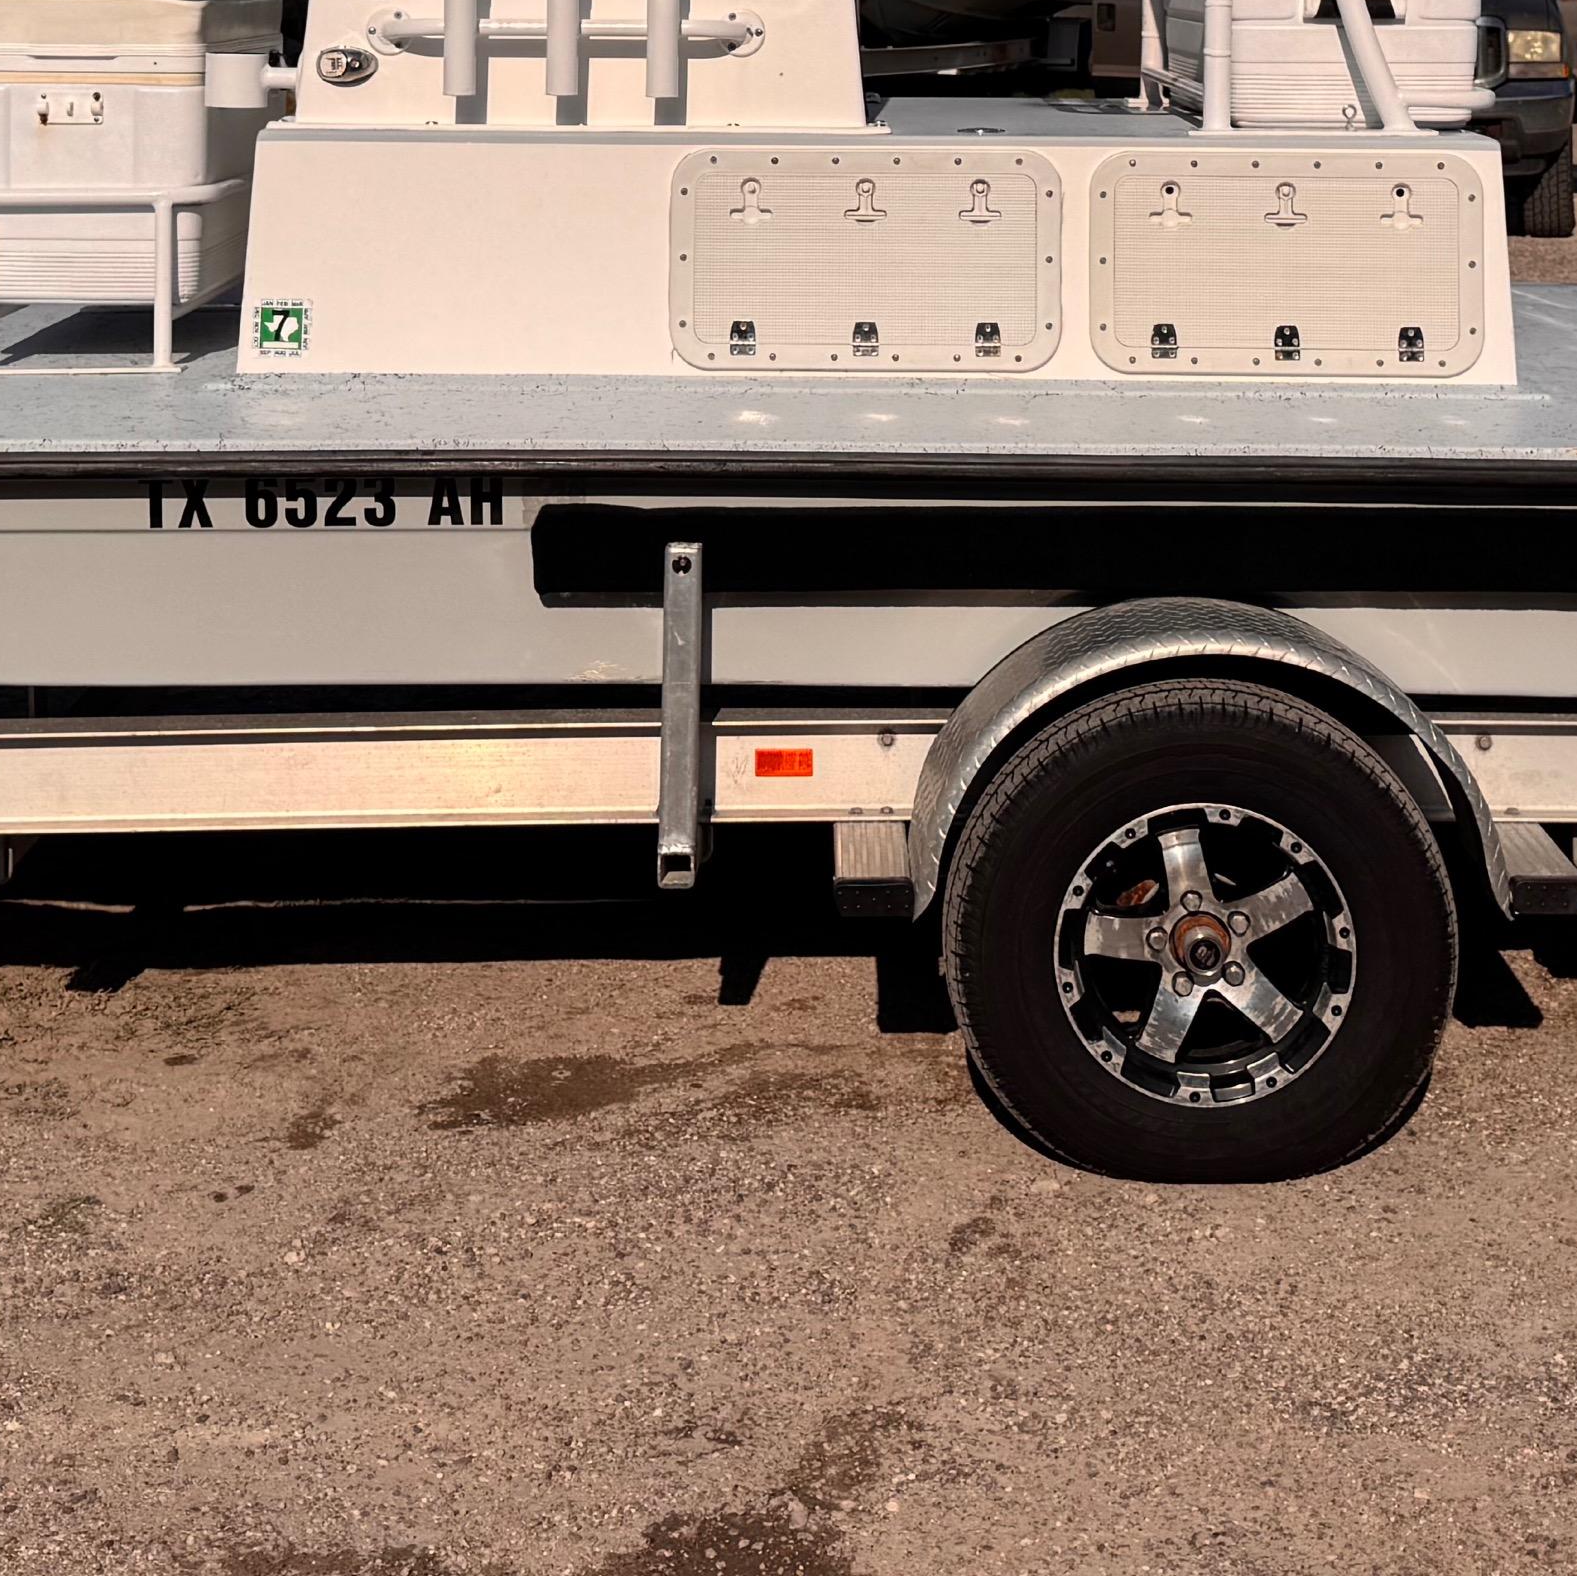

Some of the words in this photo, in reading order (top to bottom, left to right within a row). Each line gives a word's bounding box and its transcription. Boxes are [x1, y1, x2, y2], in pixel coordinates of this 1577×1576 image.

[138, 479, 214, 529] TX
[245, 478, 396, 528] 6523
[427, 477, 504, 526] AH
